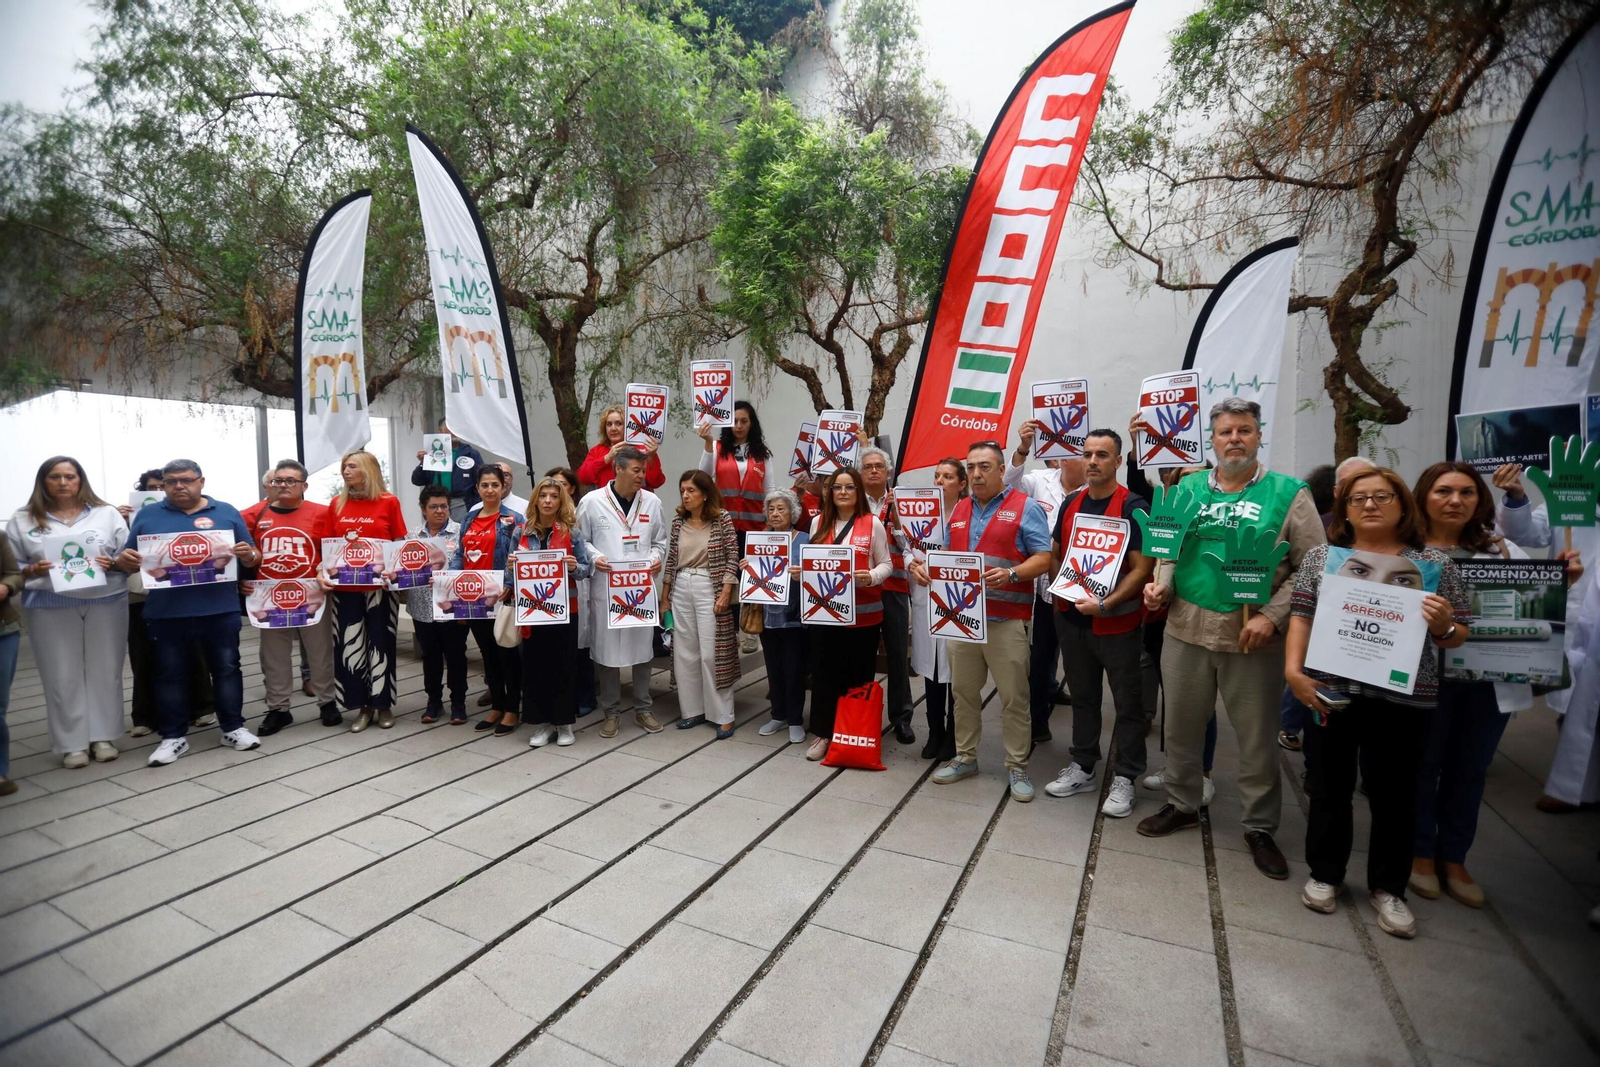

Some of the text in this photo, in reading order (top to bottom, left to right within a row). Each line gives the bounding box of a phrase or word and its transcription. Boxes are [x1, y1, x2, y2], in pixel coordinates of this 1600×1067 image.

[695, 372, 727, 385] STOP
[631, 395, 661, 407] STOP
[1044, 394, 1076, 406] STOP
[1150, 389, 1185, 404] STOP
[827, 421, 851, 431] STOP
[940, 413, 998, 432] Córdoba
[899, 501, 934, 515] STOP
[1146, 521, 1182, 529] AGRESIONES
[1076, 531, 1118, 550] STOP
[173, 543, 207, 556] STOP
[262, 536, 306, 560] UGT
[346, 549, 371, 558] STOP
[754, 545, 779, 555] STOP
[1150, 546, 1170, 554] SATSE
[402, 550, 425, 561] STOP
[520, 563, 559, 578] STOP
[812, 559, 841, 570] STOP
[612, 572, 648, 586] STOP
[939, 567, 970, 580] STOP
[456, 582, 482, 592] STOP
[275, 590, 303, 600] STOP
[1369, 598, 1381, 606] LA
[1341, 603, 1405, 623] AGRESIÓN
[1354, 619, 1381, 635] NO
[1338, 628, 1349, 637] ES
[1350, 631, 1395, 647] SOLUCIÓN
[832, 732, 869, 747] CCOO
